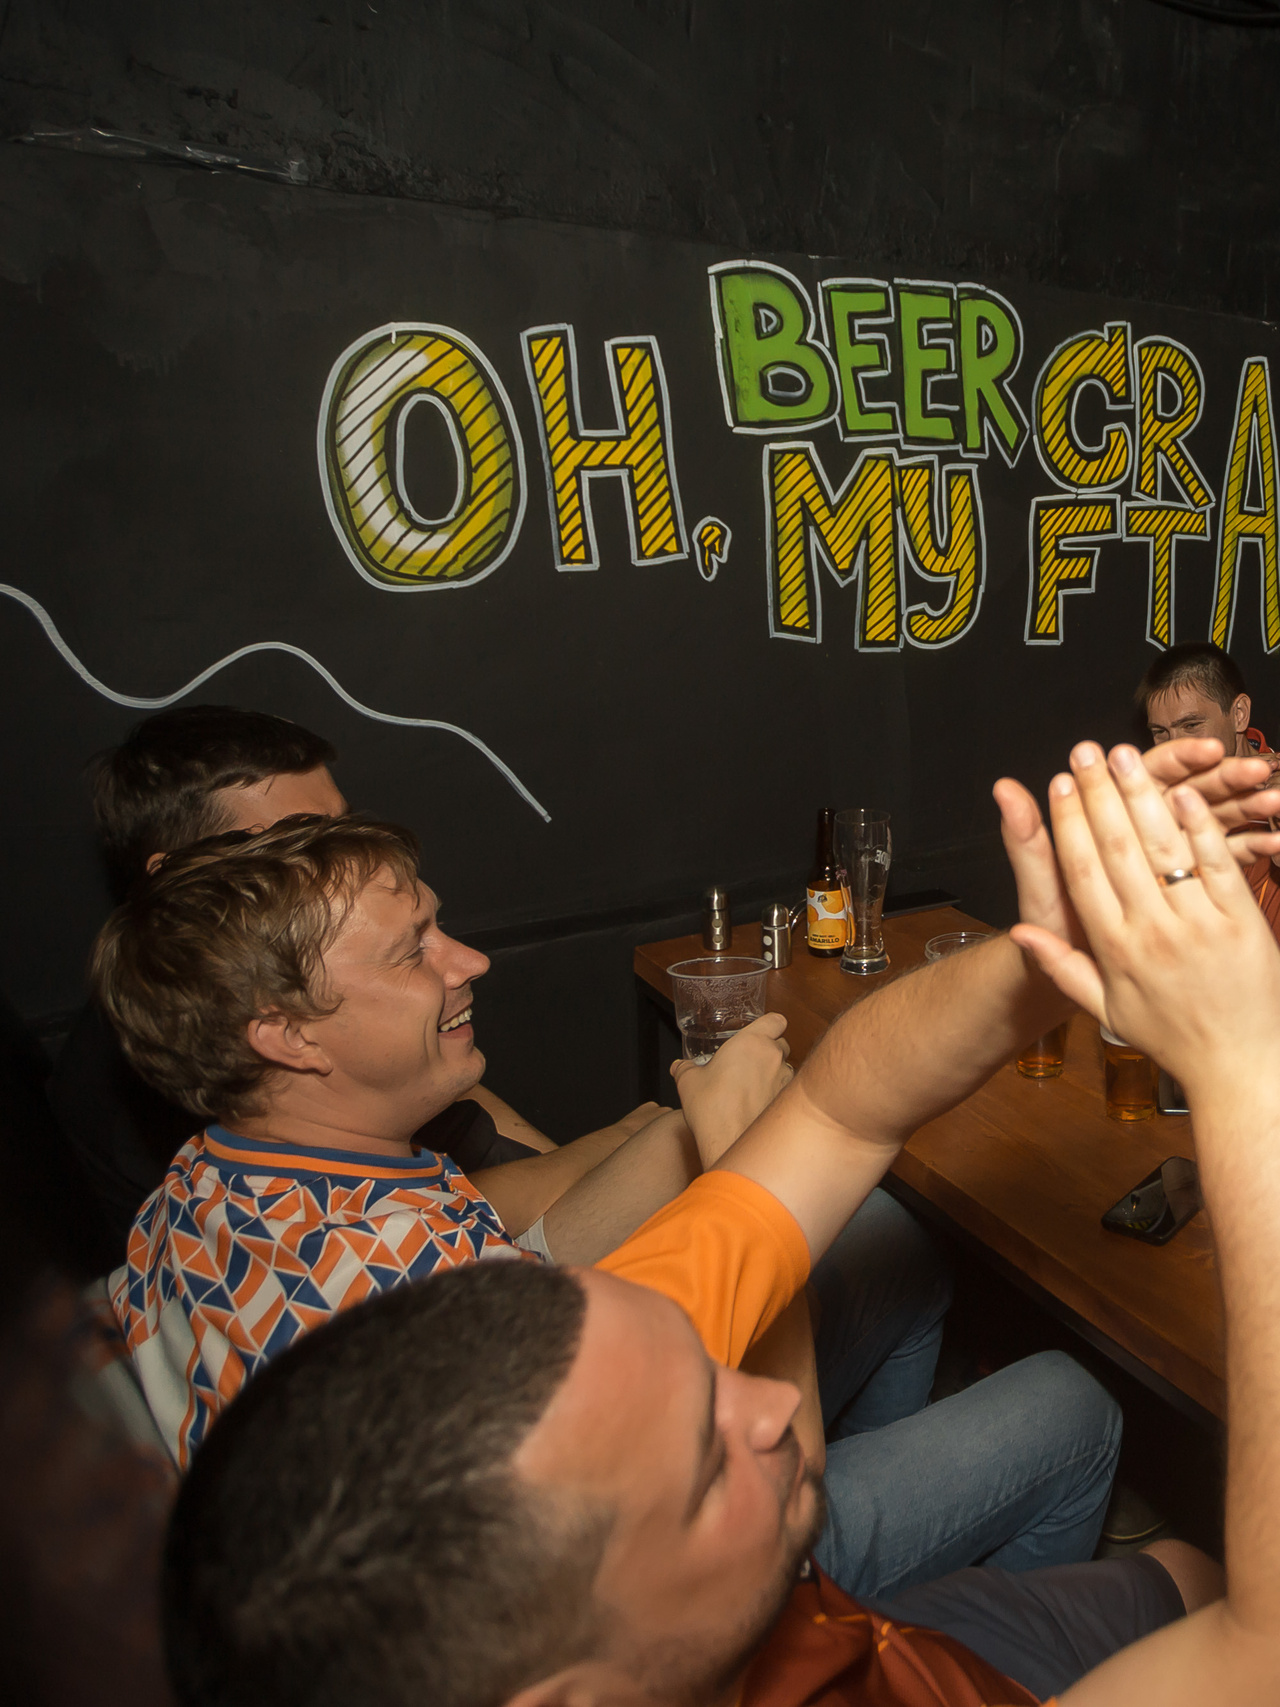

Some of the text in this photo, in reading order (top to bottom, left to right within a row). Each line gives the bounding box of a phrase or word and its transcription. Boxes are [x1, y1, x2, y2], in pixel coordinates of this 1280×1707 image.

[316, 322, 986, 652] OH, MY
[708, 258, 1029, 467] BEER
